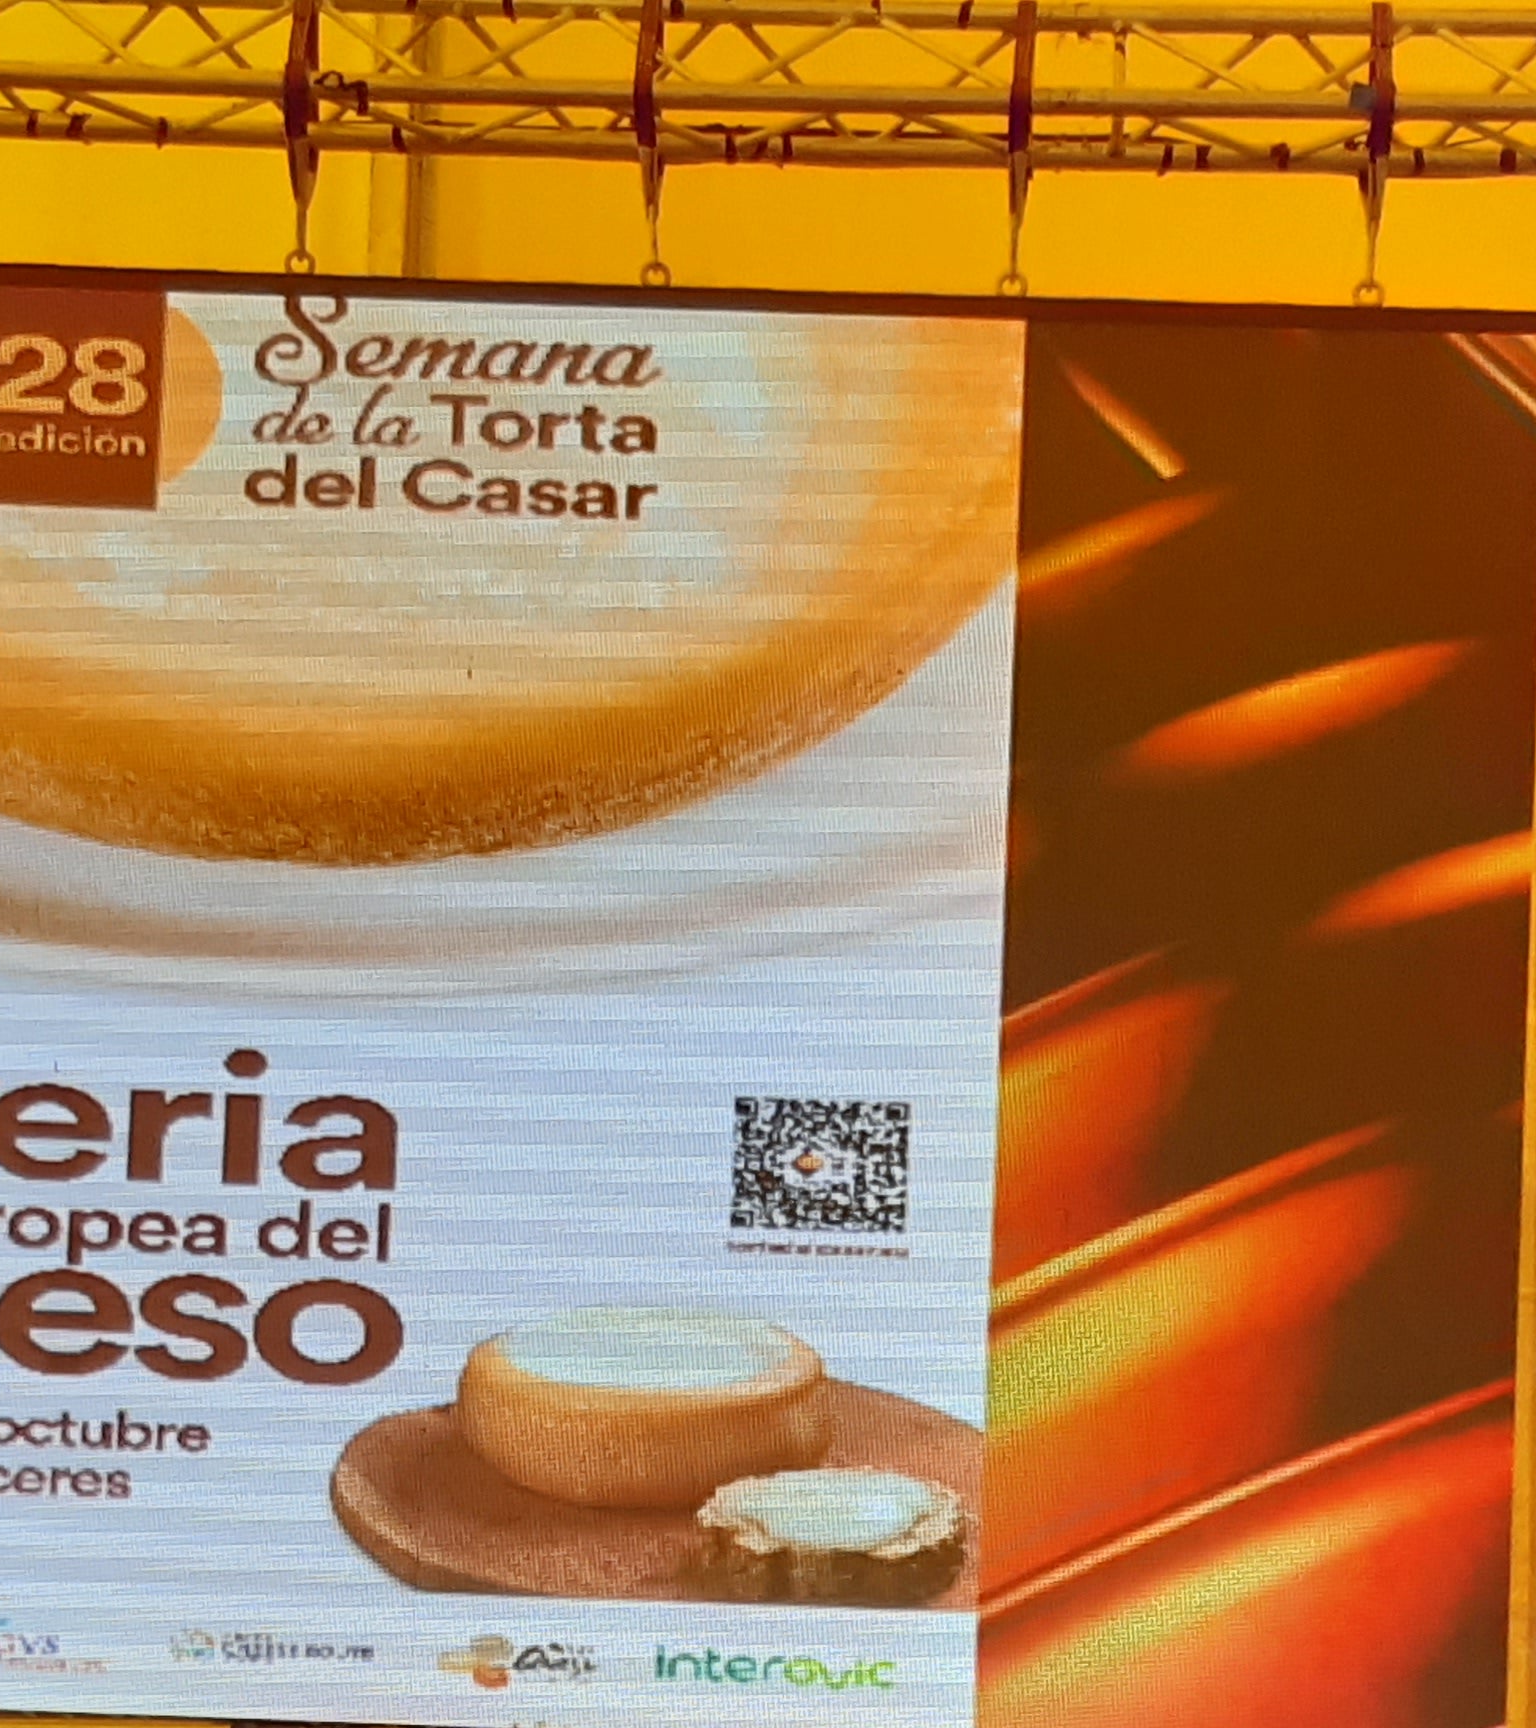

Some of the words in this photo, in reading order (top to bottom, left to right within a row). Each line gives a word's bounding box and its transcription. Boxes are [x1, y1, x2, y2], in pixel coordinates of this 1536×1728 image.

[254, 294, 663, 389] Semana
[253, 384, 335, 446] de
[353, 384, 422, 446] la
[430, 394, 658, 456] Torta
[243, 453, 376, 509] del
[401, 458, 658, 521] Casar
[256, 1199, 391, 1263] del
